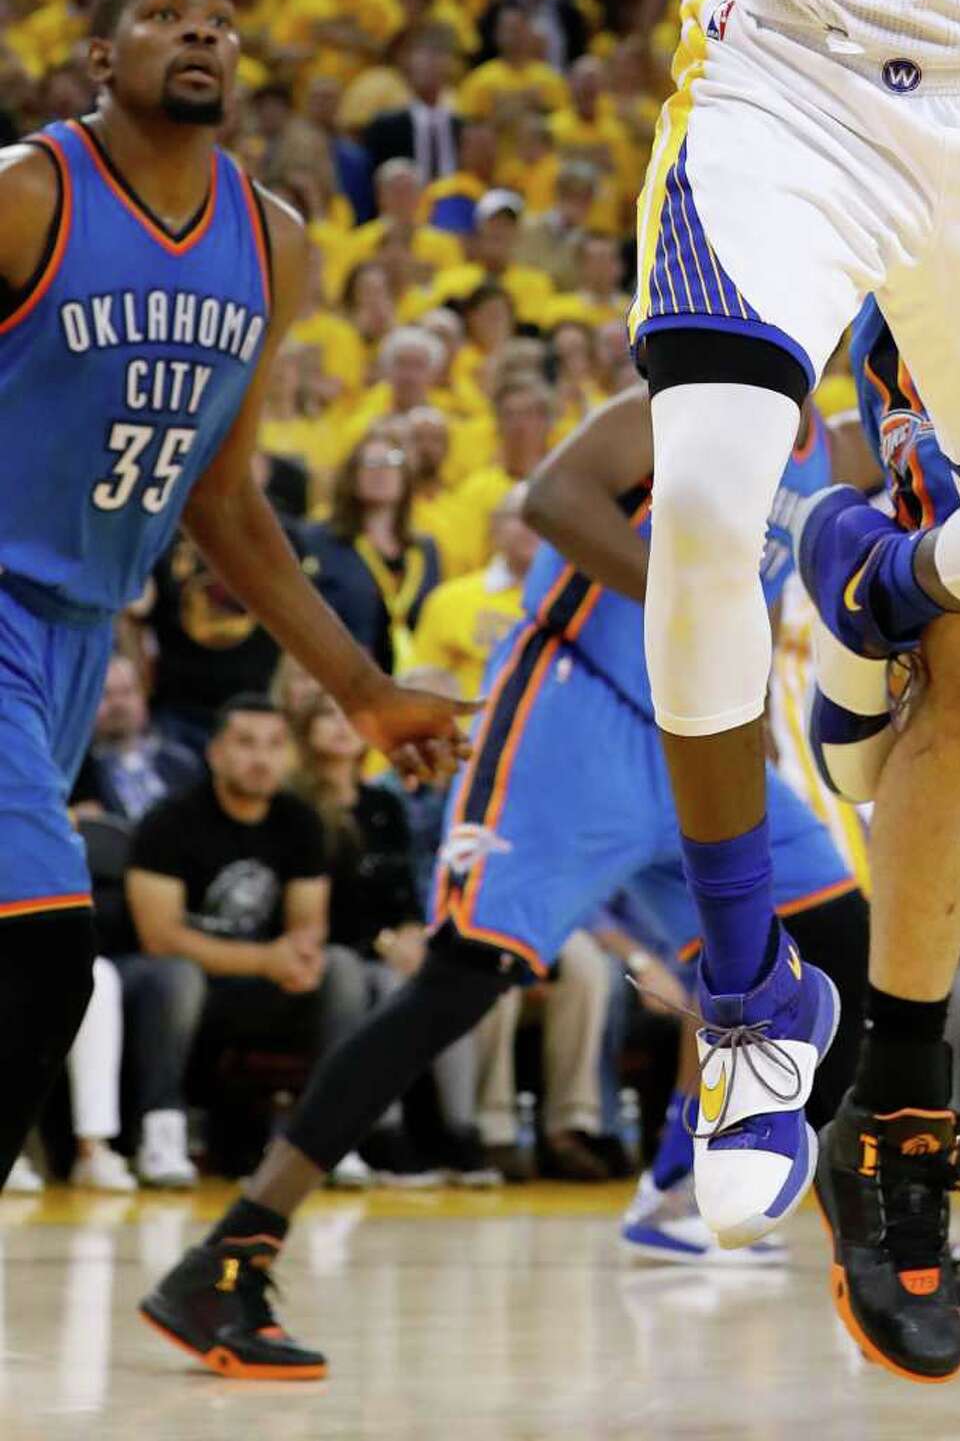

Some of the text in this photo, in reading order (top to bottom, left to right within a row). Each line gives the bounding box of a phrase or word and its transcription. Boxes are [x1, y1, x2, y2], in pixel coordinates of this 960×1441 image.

[61, 290, 265, 362] OKLAHOMA
[126, 359, 213, 413] CITY
[92, 422, 199, 513] 35
